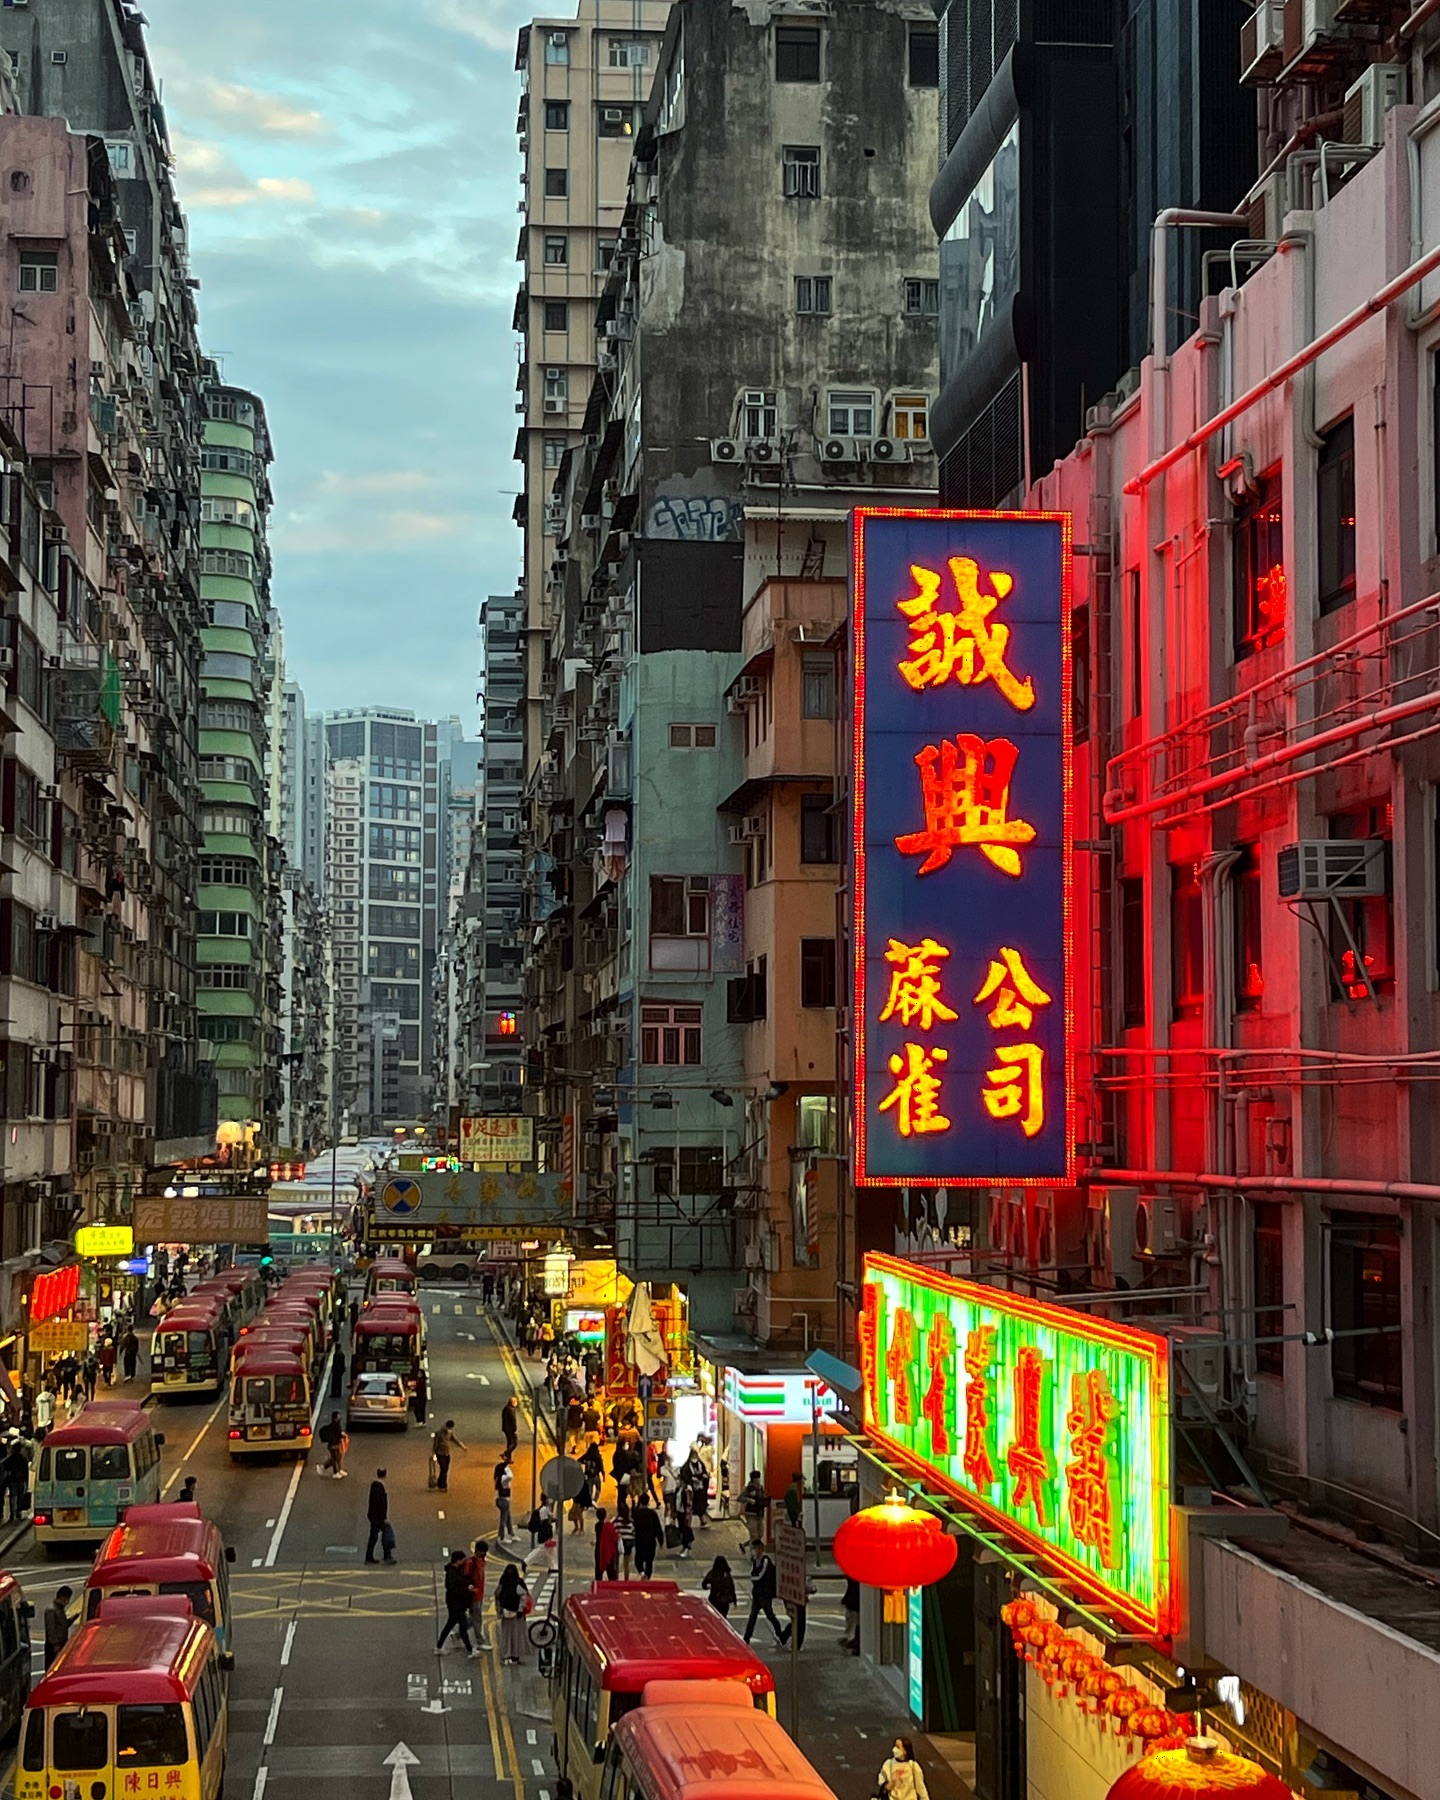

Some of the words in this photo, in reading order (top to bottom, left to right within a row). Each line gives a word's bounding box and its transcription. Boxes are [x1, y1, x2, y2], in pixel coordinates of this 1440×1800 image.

[896, 556, 1037, 877] 誠興
[974, 946, 1051, 1137] 公司
[124, 1769, 183, 1794] 陳日興
